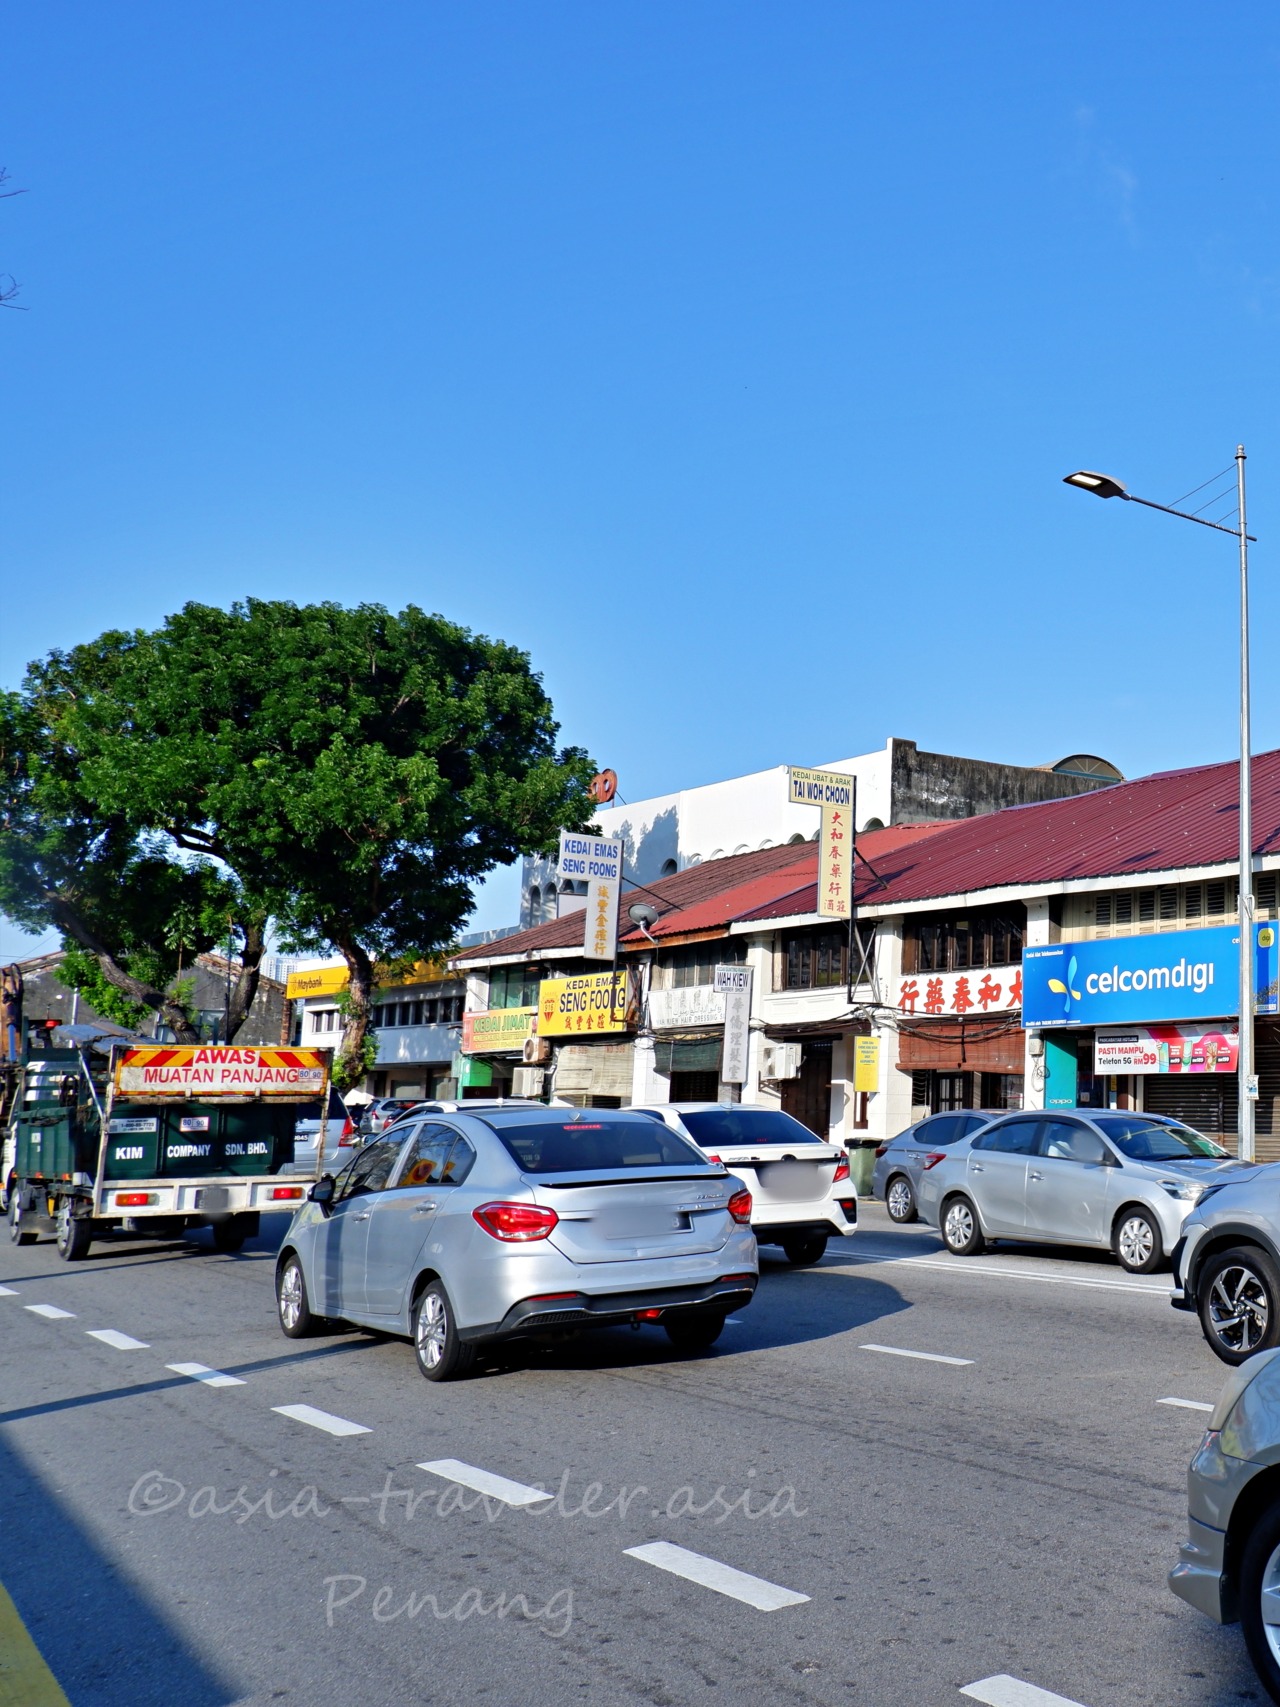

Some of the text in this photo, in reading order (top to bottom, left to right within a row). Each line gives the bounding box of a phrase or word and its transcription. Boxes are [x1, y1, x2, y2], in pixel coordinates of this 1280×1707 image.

[792, 770, 810, 780] KEDAI
[812, 774, 828, 782] UBAT
[835, 778, 851, 786] ARAK
[794, 780, 850, 805] TAI WOH CHOON
[564, 839, 618, 858] KEDAI EMAS
[562, 858, 617, 878] SENG FOONG
[298, 976, 322, 992] Maybank
[566, 976, 621, 990] KEDAI EMAS
[718, 972, 749, 987] WAH KIEW
[1086, 958, 1214, 994] celcomdigi
[560, 988, 625, 1013] SENG FOOG
[474, 1014, 531, 1033] KEDAI JIMAT
[195, 1050, 257, 1065] AWAS
[1134, 1053, 1156, 1065] RM99
[144, 1068, 298, 1083] MUATAN PANJANG
[182, 1118, 192, 1126] 80
[116, 1142, 268, 1159] KIM COMPANY SDN. BHD.
